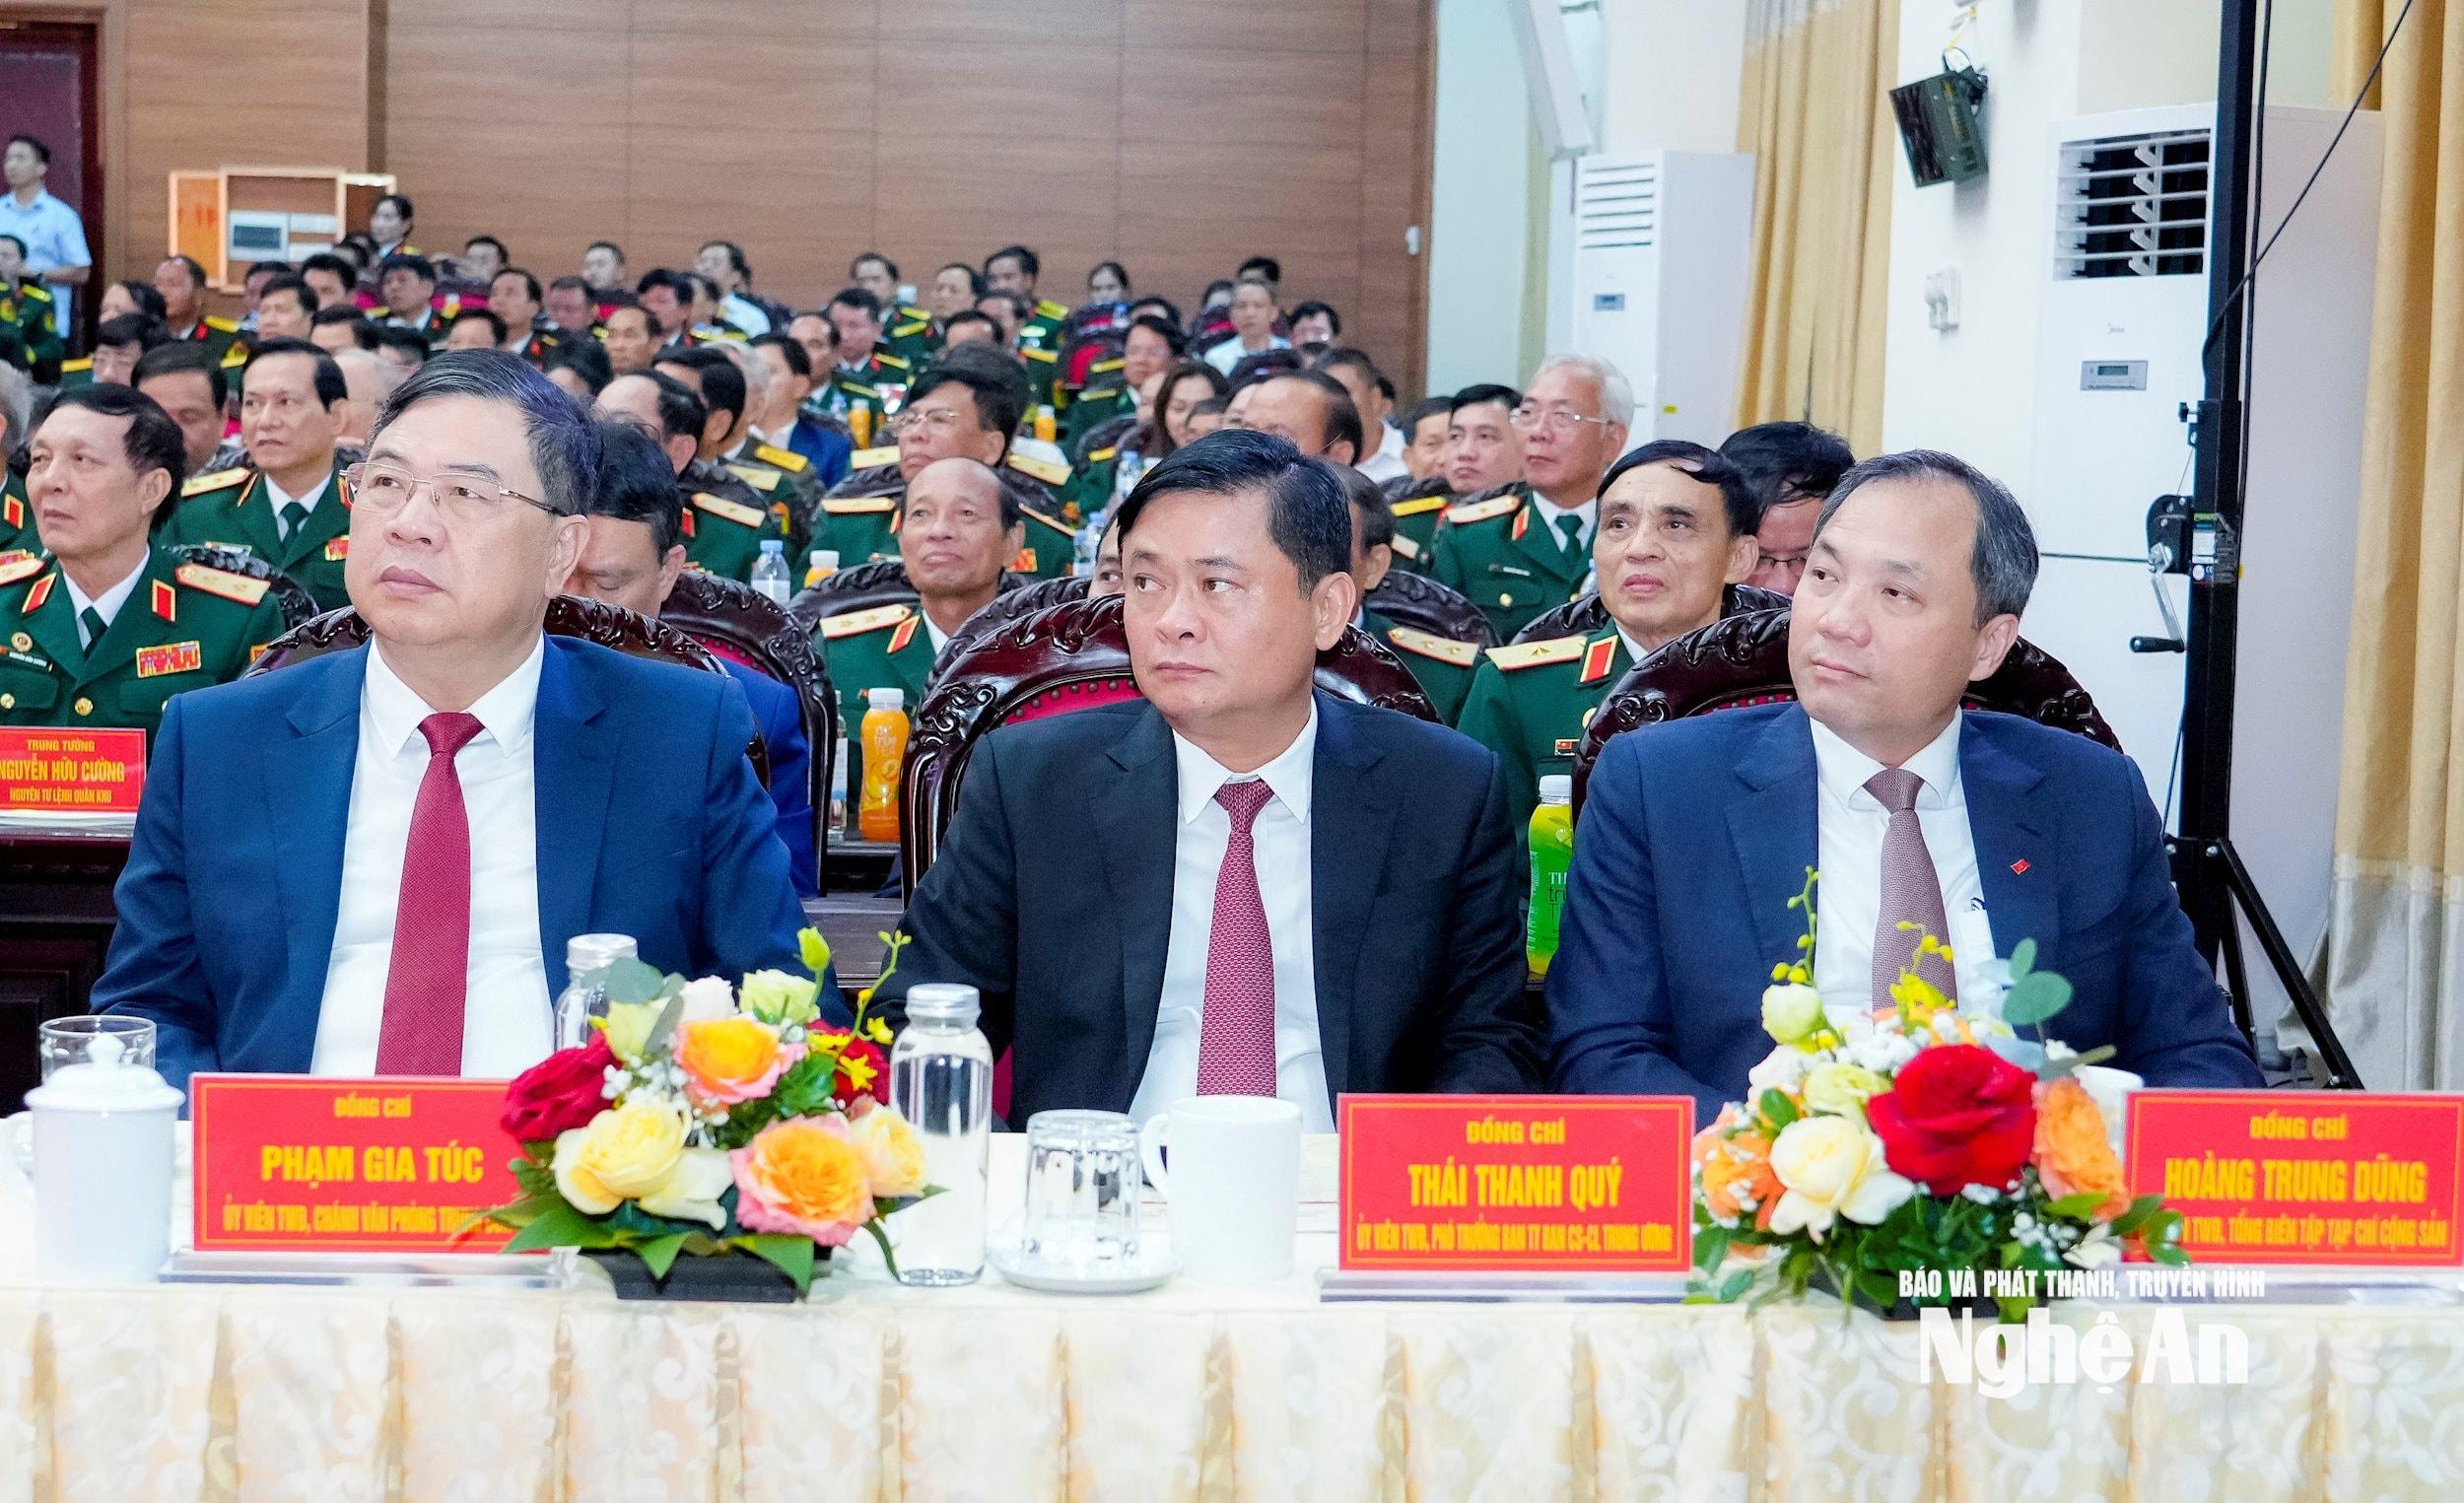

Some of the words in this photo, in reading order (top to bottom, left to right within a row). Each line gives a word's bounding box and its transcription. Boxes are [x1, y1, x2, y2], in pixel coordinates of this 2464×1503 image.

[27, 739, 60, 752] TRUNG
[62, 738, 96, 752] TƯỚNG
[0, 753, 48, 782] NGUYỄN
[51, 756, 78, 782] HỮU
[81, 756, 125, 783] CƯỜNG
[9, 786, 40, 802] NGUYÊN
[96, 788, 112, 804] KHU
[333, 1091, 380, 1119] ĐỒNG
[383, 1093, 412, 1119] CHÍ
[1467, 1114, 1523, 1144] ĐỒNG
[1529, 1116, 1565, 1144] CHÍ
[2249, 1110, 2306, 1140] ĐỒNG
[2311, 1113, 2348, 1140] CHÍ
[261, 1144, 355, 1190] PHẠM
[363, 1145, 417, 1182] GIA
[423, 1138, 485, 1184] TÚC
[2164, 1149, 2256, 1201] HOÀNG
[2262, 1159, 2347, 1201] TRUNG
[2353, 1153, 2429, 1203] DŨNG
[1407, 1156, 1468, 1207] THÁI
[1474, 1164, 1563, 1207] THANH
[1569, 1156, 1623, 1211] QUÝ
